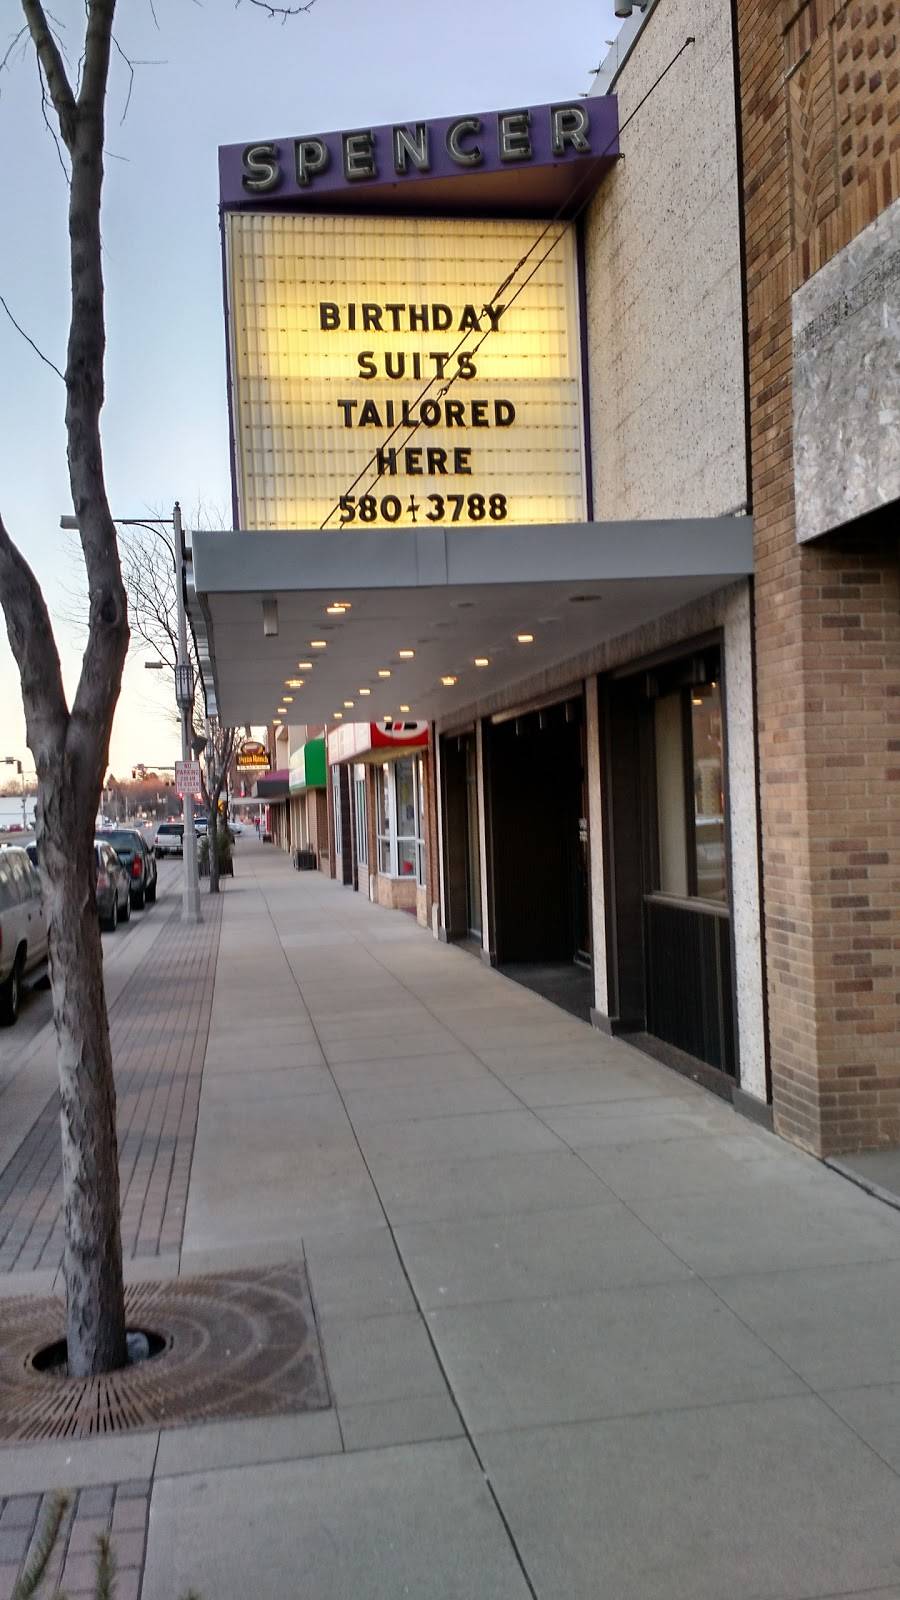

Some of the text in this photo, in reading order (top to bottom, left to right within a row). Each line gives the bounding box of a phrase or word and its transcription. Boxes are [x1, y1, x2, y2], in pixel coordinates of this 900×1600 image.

[241, 103, 592, 194] SPENCER
[319, 302, 506, 332] BIRTHDAY
[358, 351, 478, 380] SUITS
[338, 399, 516, 428] TAILORED
[376, 447, 473, 476] HERE
